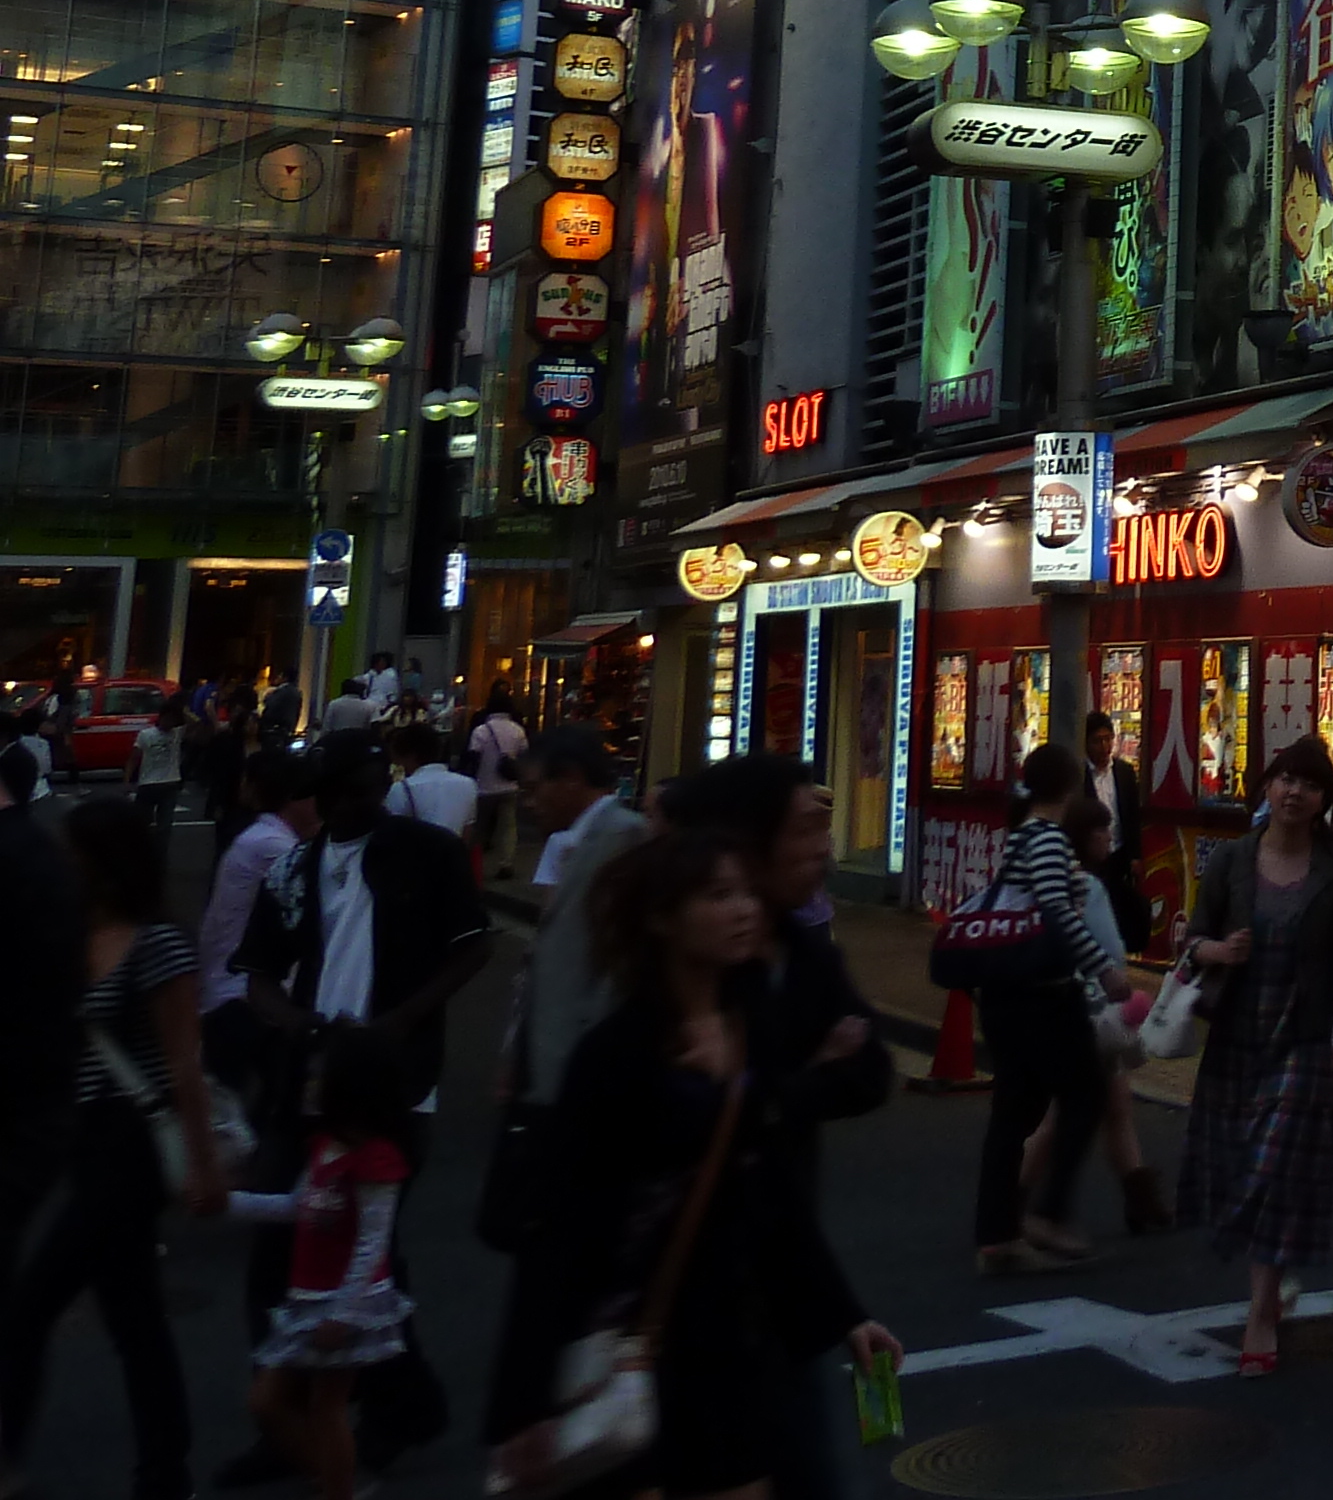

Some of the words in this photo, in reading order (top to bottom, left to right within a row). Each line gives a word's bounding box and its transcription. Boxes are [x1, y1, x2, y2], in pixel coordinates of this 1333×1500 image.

[586, 10, 603, 23] 5F
[564, 52, 615, 79] 和民
[560, 133, 610, 157] 和民
[944, 118, 1148, 157] 渋谷センター街
[565, 237, 592, 248] 2F
[533, 374, 595, 408] HUB
[763, 391, 825, 455] SLOT
[1077, 437, 1089, 455] A
[1034, 508, 1084, 538] 埼玉
